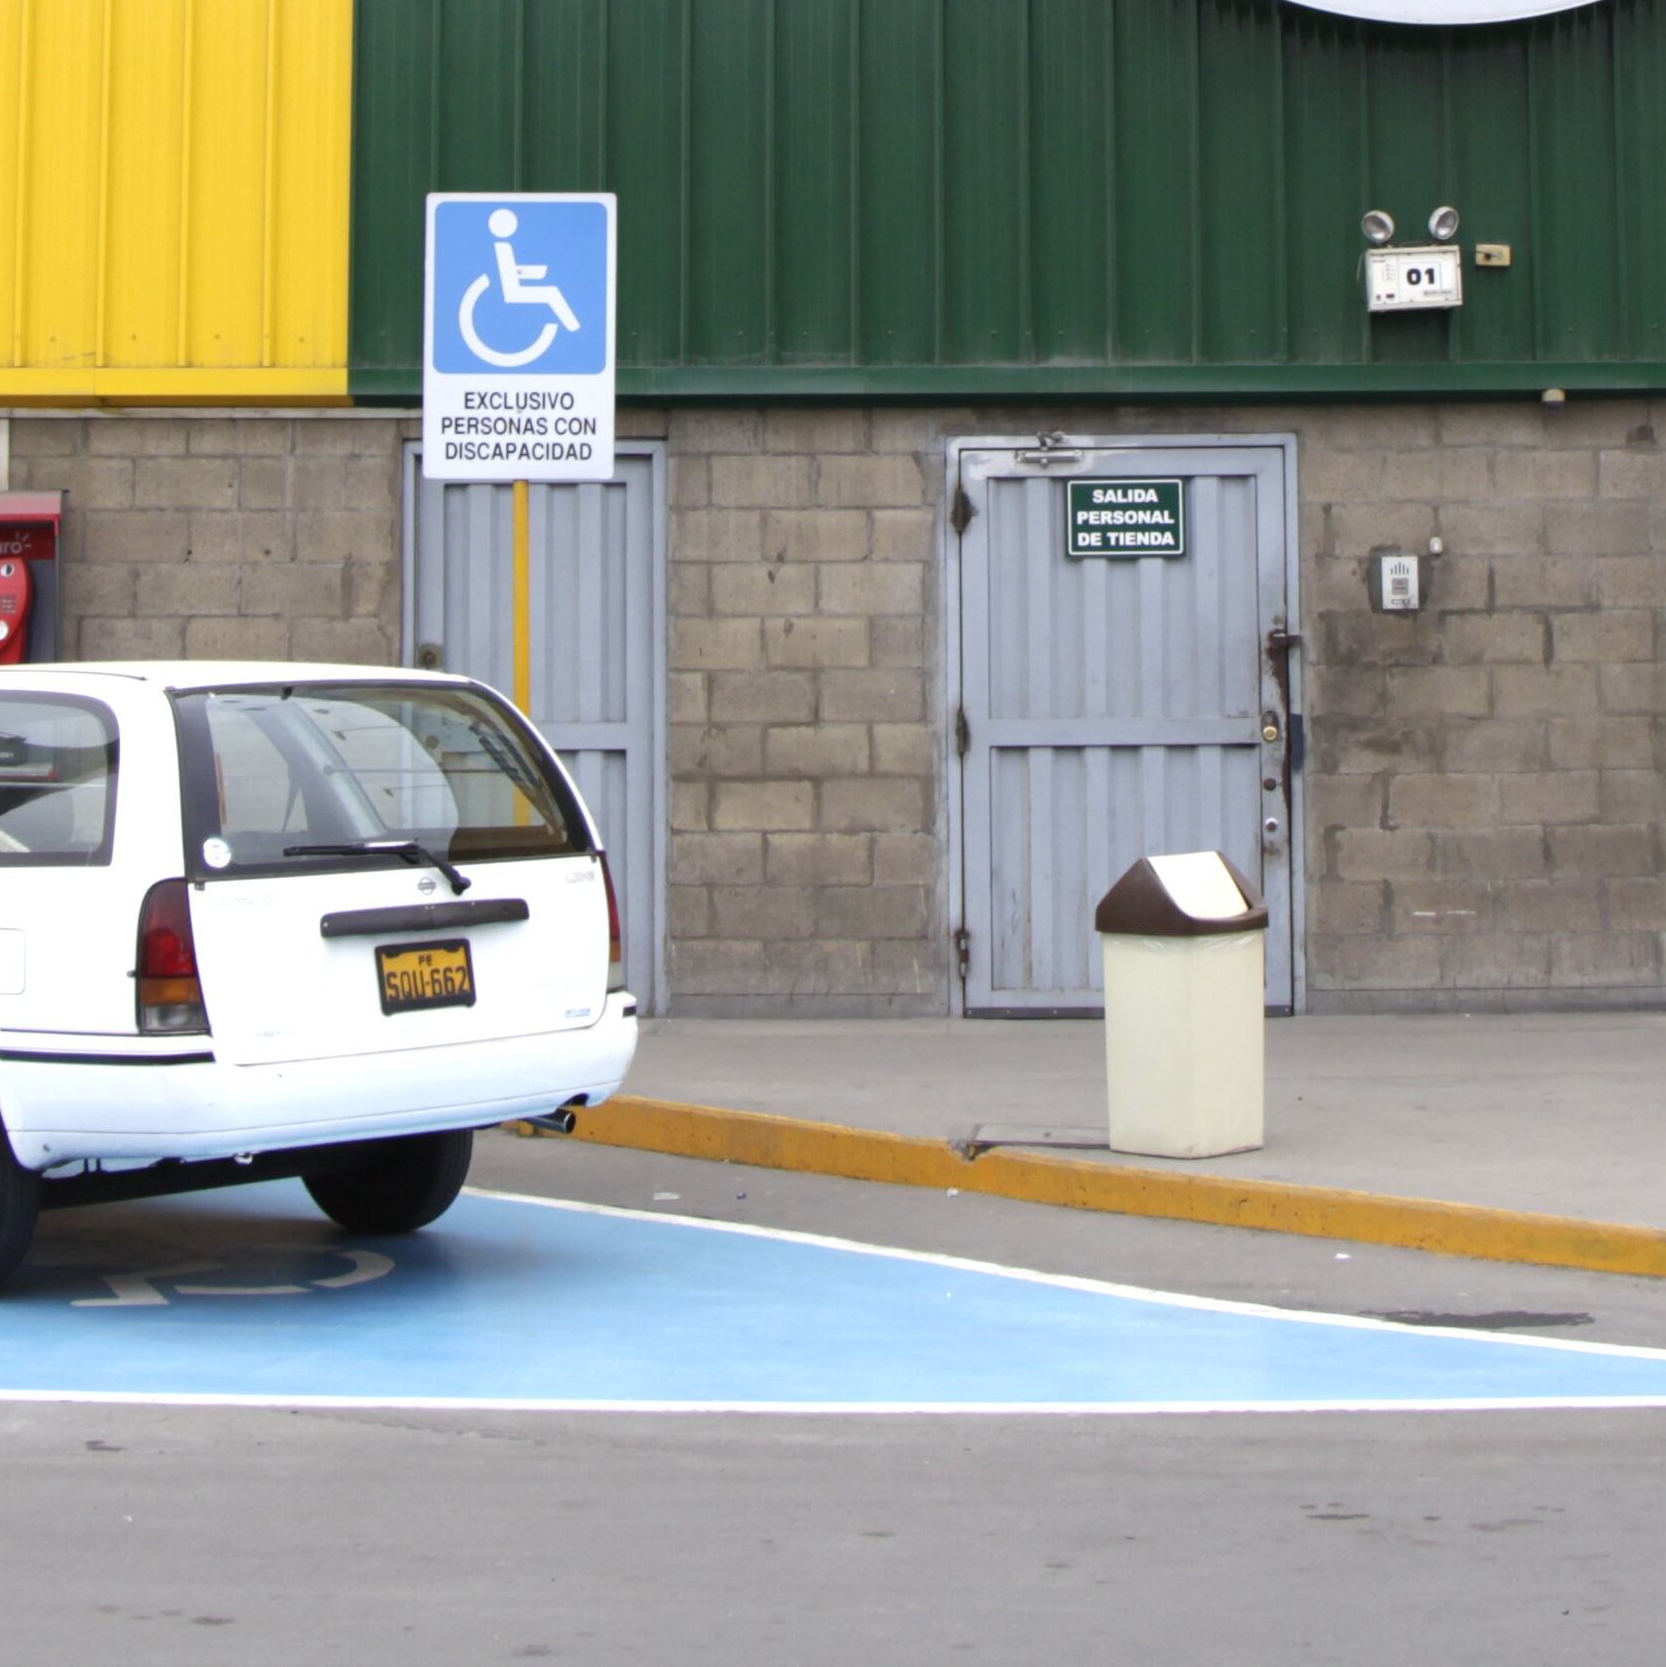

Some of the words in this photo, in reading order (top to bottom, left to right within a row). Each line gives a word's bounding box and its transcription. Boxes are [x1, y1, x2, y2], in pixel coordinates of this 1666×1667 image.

[1406, 267, 1436, 286] 01
[464, 391, 575, 411] EXCLUSIVO
[441, 417, 548, 436] PERSONAS
[554, 417, 597, 436] CON
[445, 441, 593, 462] DISCAPACIDAD
[1092, 489, 1159, 504] SALIDA
[1077, 510, 1175, 526] PERSONAL
[1077, 532, 1102, 547] DE
[1107, 531, 1175, 547] TIENDA
[418, 954, 433, 966] PE
